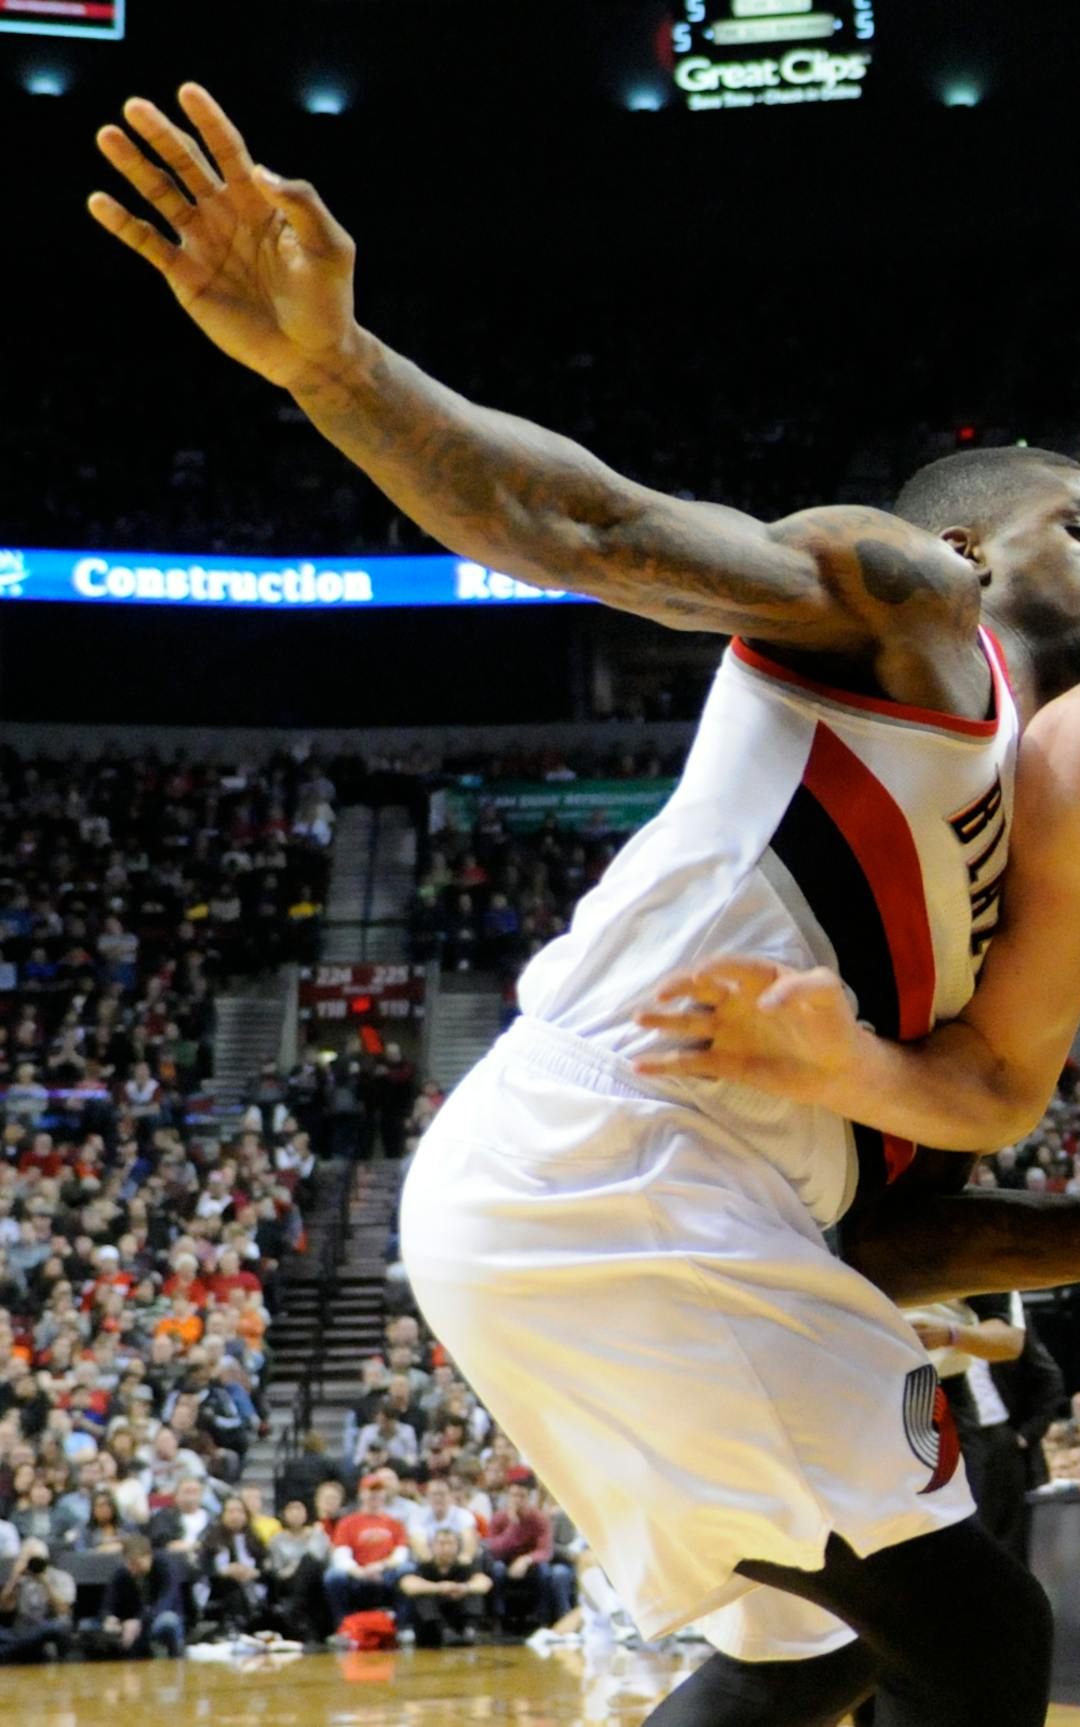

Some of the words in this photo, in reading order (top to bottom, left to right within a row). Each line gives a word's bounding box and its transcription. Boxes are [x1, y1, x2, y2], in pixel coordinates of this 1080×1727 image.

[675, 55, 780, 91] Great
[780, 48, 867, 91] Clips
[73, 557, 373, 602] Construction
